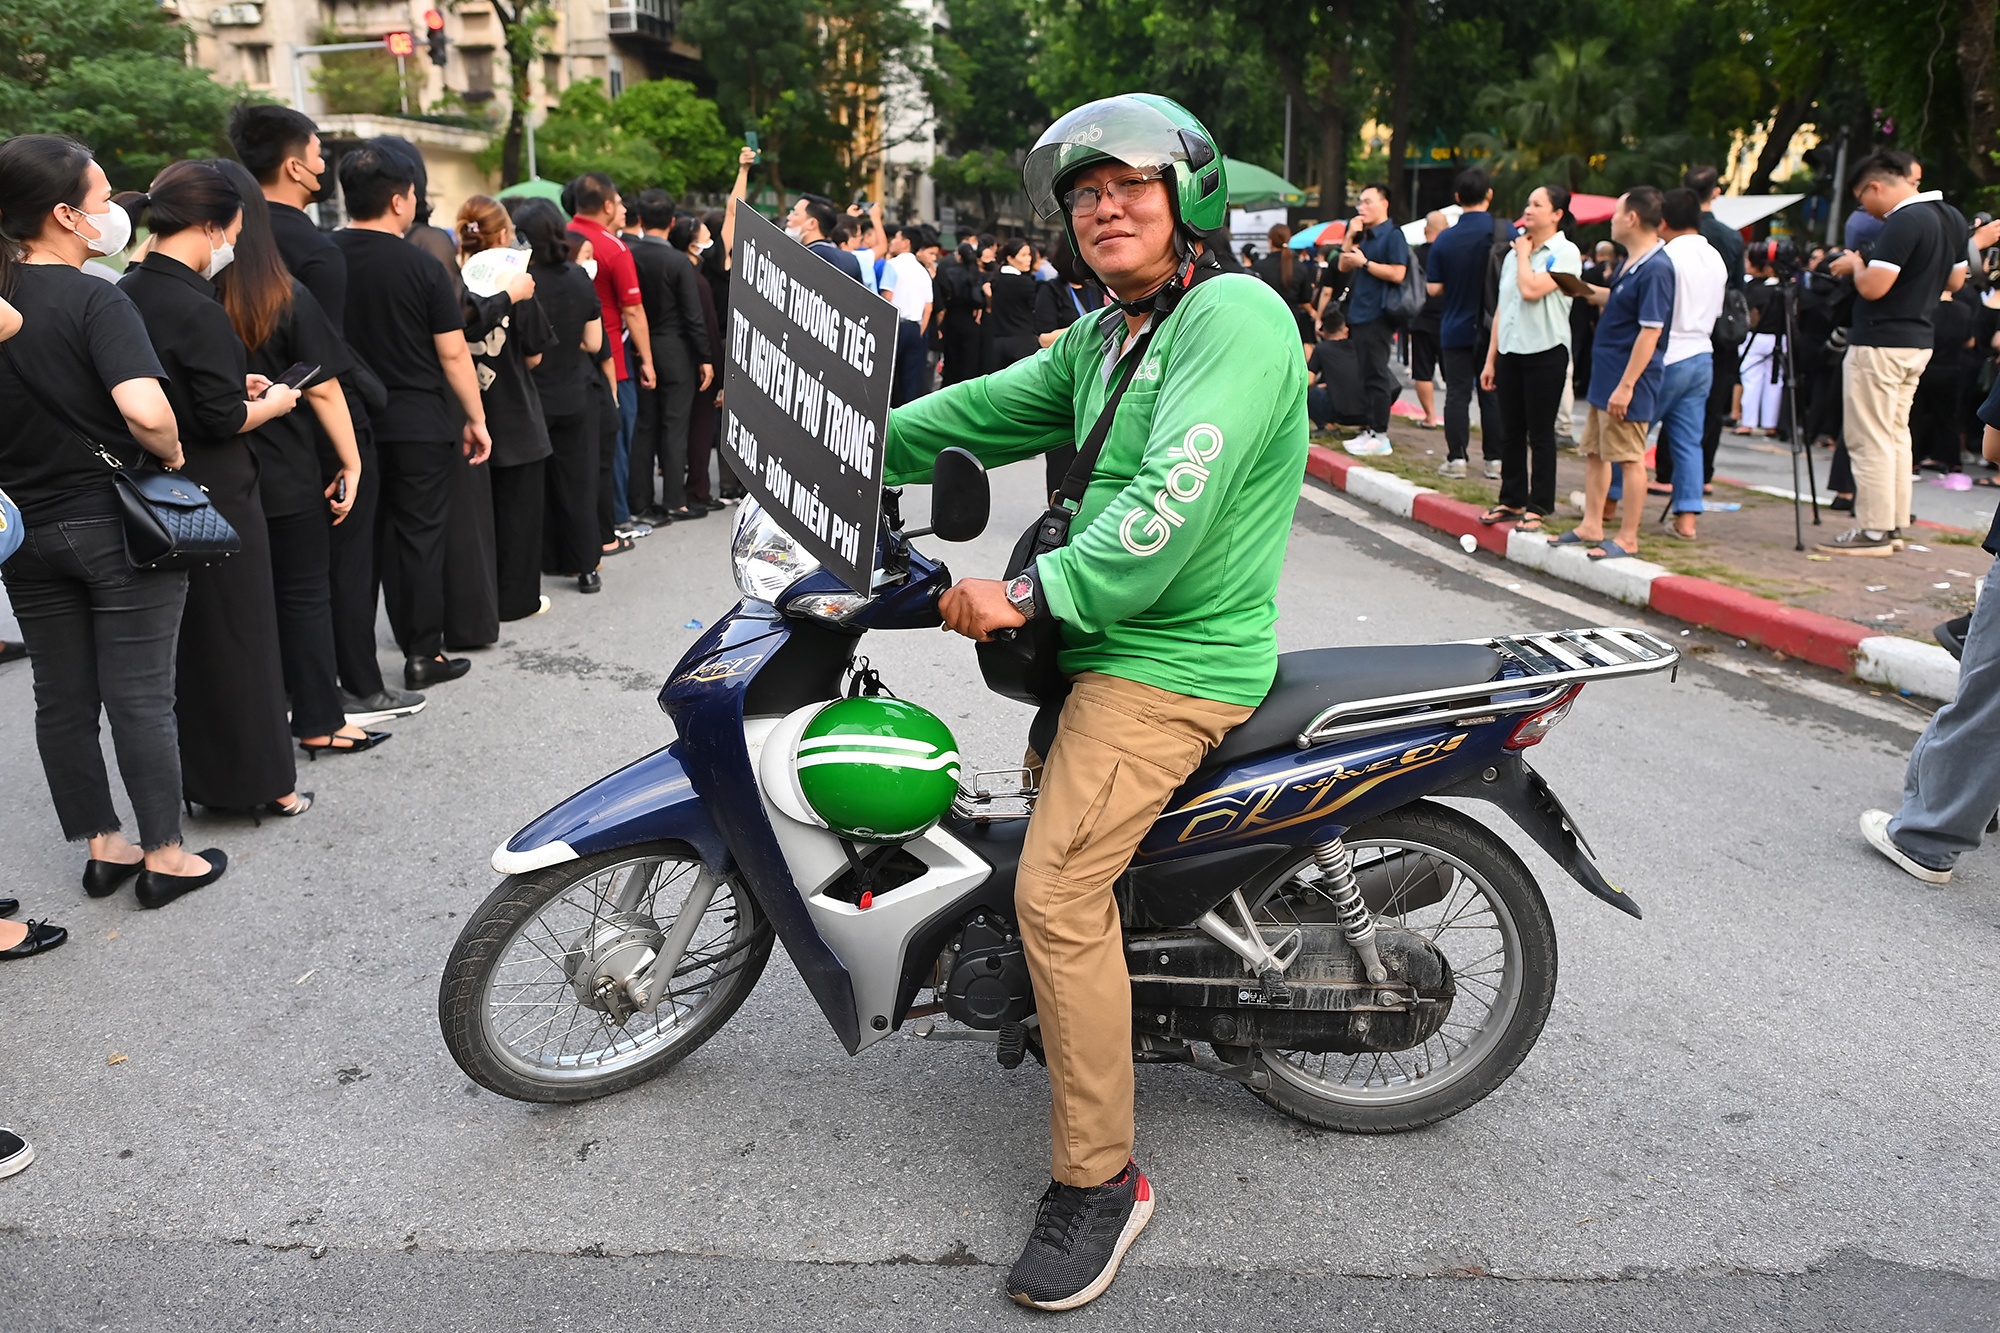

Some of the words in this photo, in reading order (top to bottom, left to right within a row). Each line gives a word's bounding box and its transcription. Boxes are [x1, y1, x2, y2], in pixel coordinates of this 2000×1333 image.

[742, 237, 756, 286] VÔ
[756, 250, 787, 313] CÙNG
[788, 277, 841, 354] THƯƠNG
[842, 315, 876, 378] TIẾC
[749, 331, 796, 416] NGUYỄN
[793, 370, 825, 438] PHÚ
[823, 389, 876, 481] TRỌNG
[726, 409, 739, 452] XE
[738, 424, 758, 476] ĐƯA
[765, 454, 792, 509] ĐÓN
[791, 480, 830, 543] MIỄN
[830, 512, 862, 567] PHÍ
[1119, 422, 1224, 557] Grab
